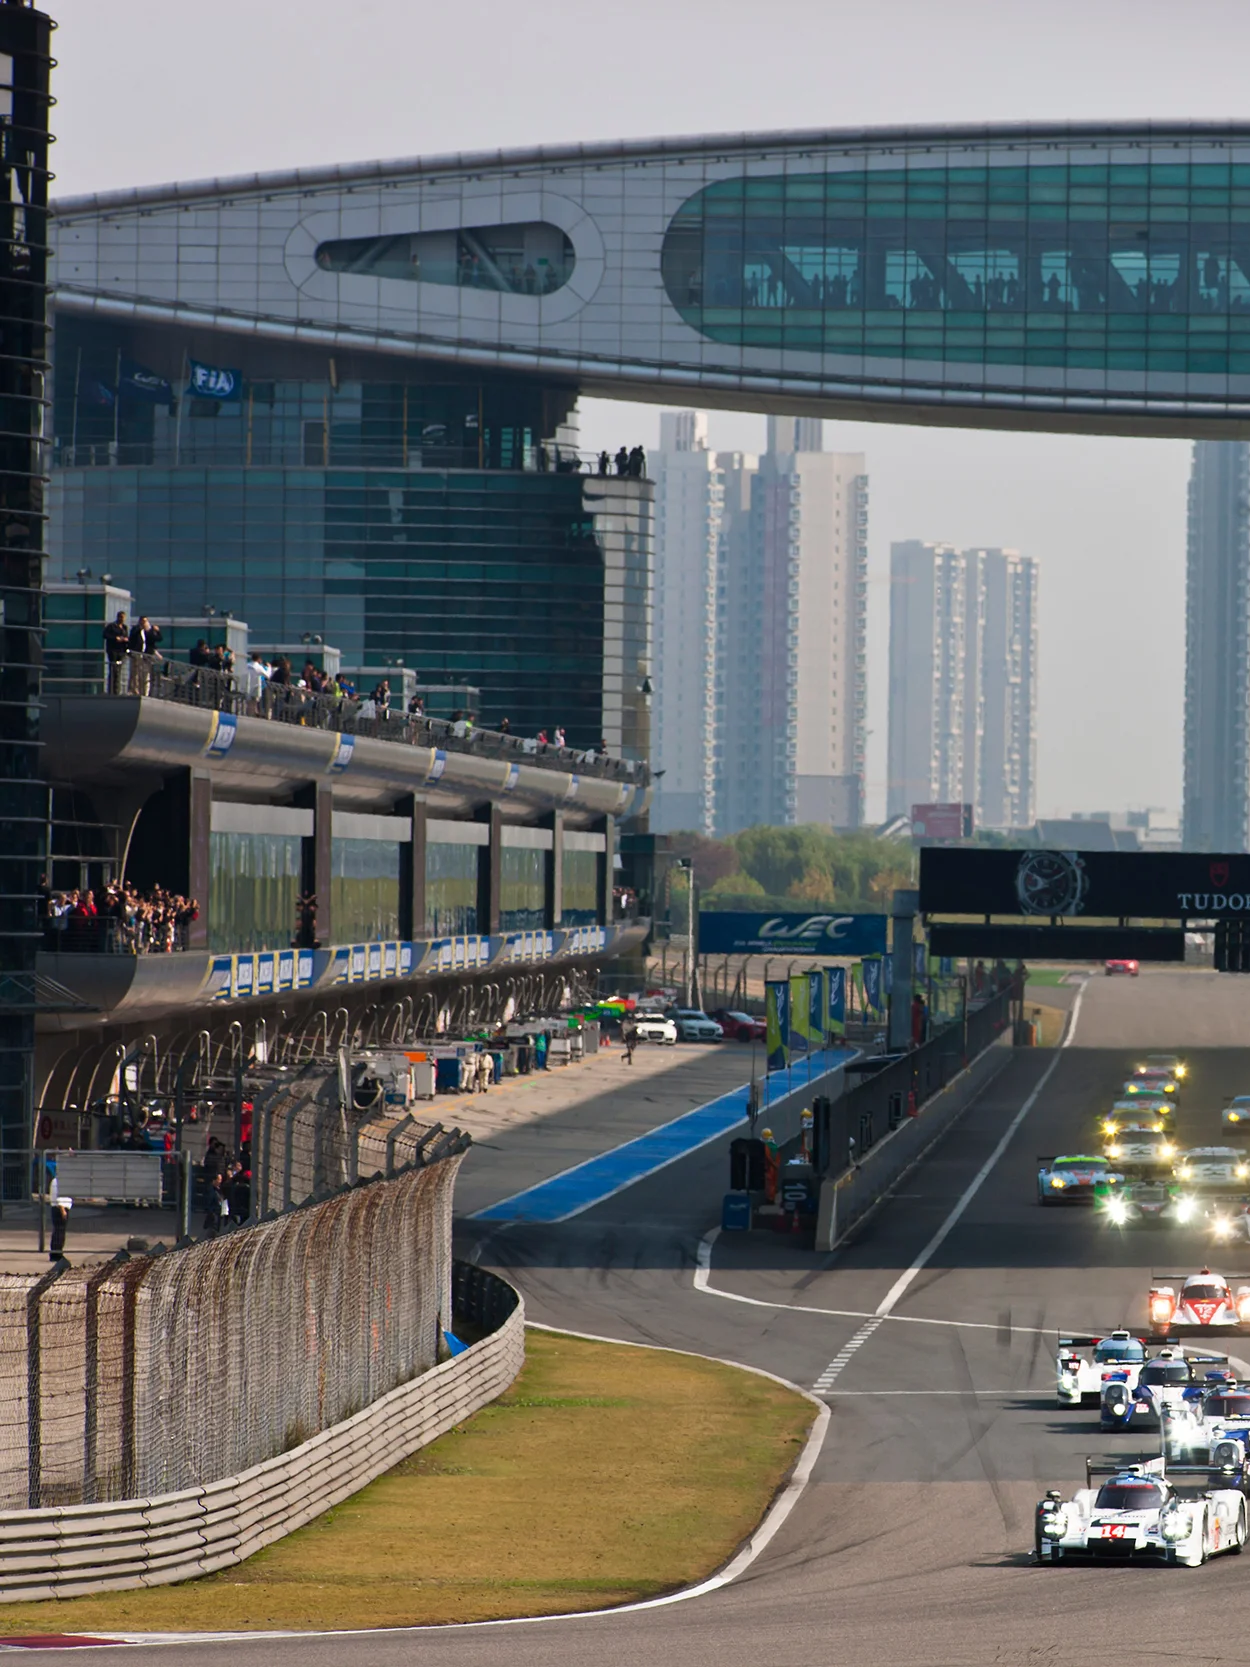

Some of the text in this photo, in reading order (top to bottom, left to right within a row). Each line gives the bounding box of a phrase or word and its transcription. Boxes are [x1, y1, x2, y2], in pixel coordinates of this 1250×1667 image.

[758, 915, 854, 938] WEC
[831, 971, 841, 1006] WEC
[784, 1182, 807, 1201] 10
[1198, 1305, 1213, 1315] 12
[1101, 1524, 1126, 1538] 14
